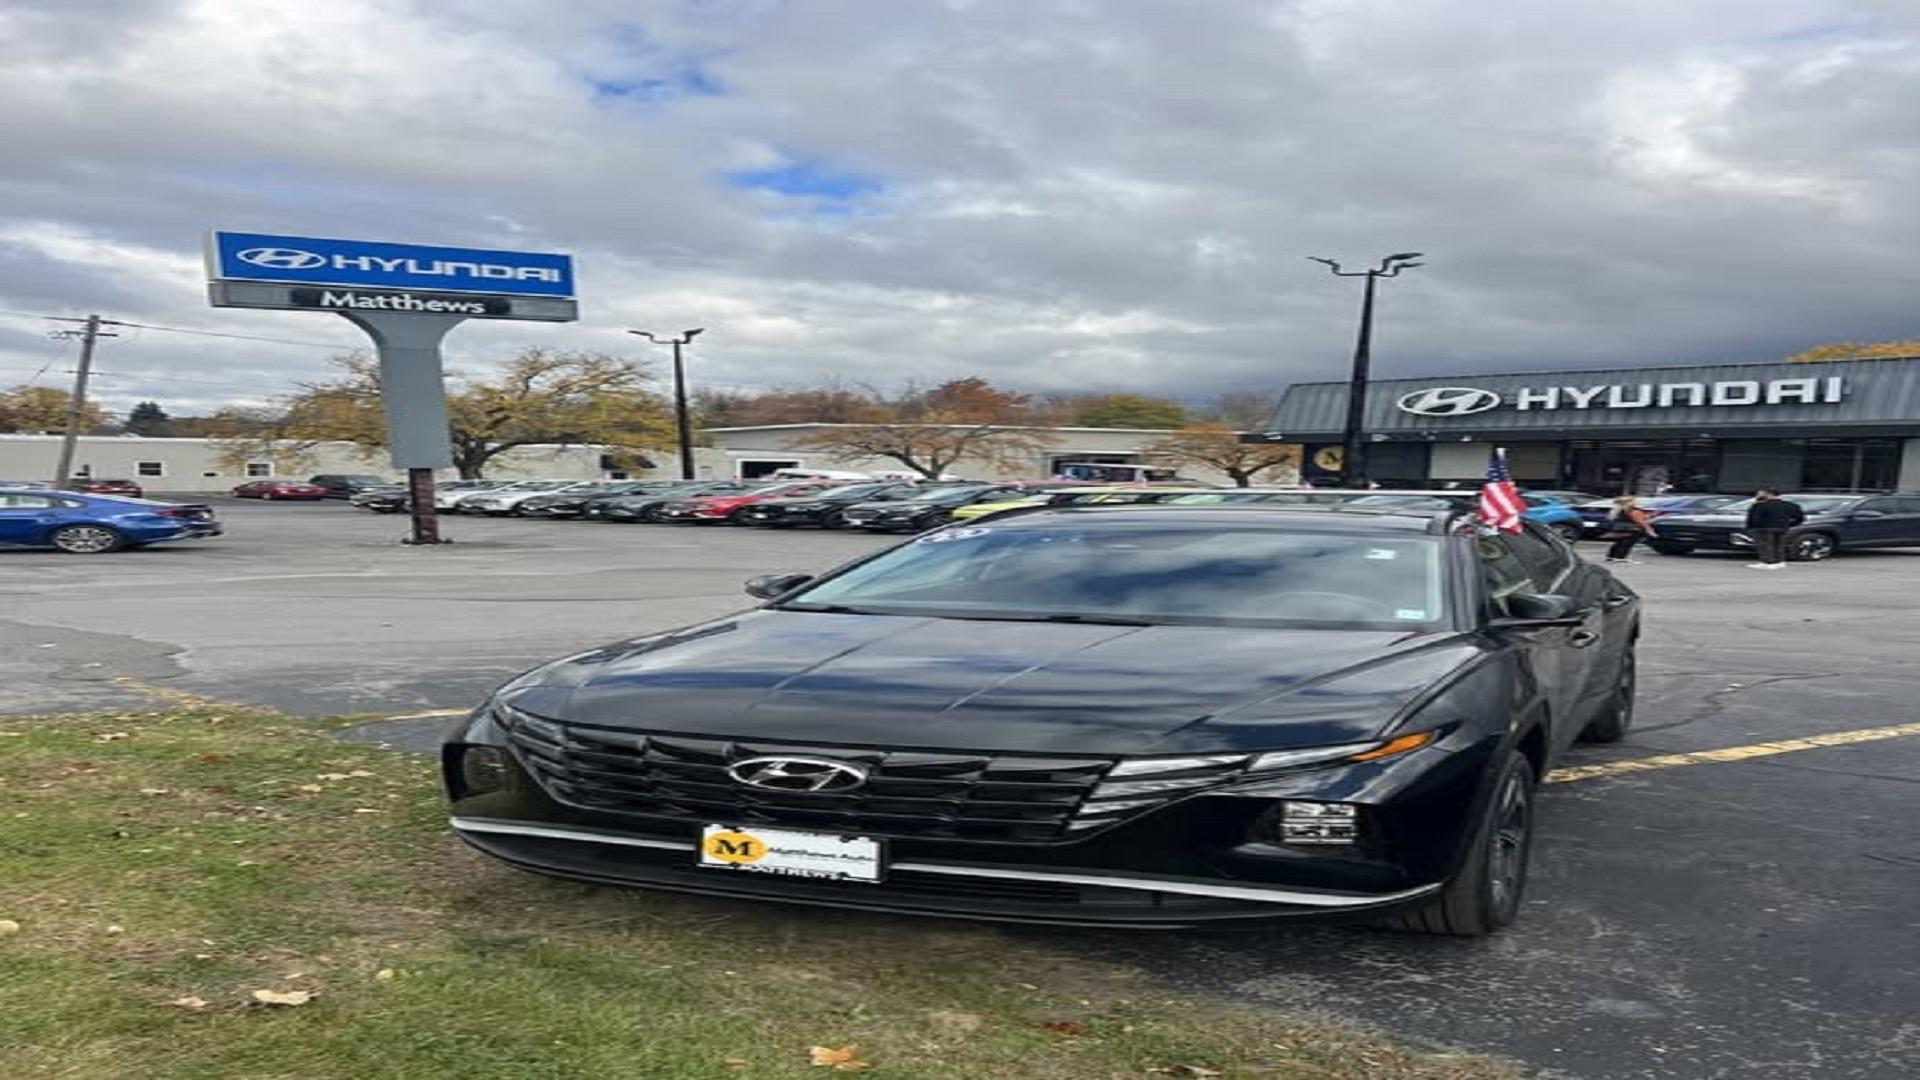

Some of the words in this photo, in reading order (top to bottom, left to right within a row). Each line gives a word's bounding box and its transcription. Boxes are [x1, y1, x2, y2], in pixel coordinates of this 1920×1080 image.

[332, 254, 560, 282] HYUNDAI
[319, 290, 487, 315] Matthews
[1516, 376, 1842, 410] HYUNDAI
[713, 838, 753, 857] M
